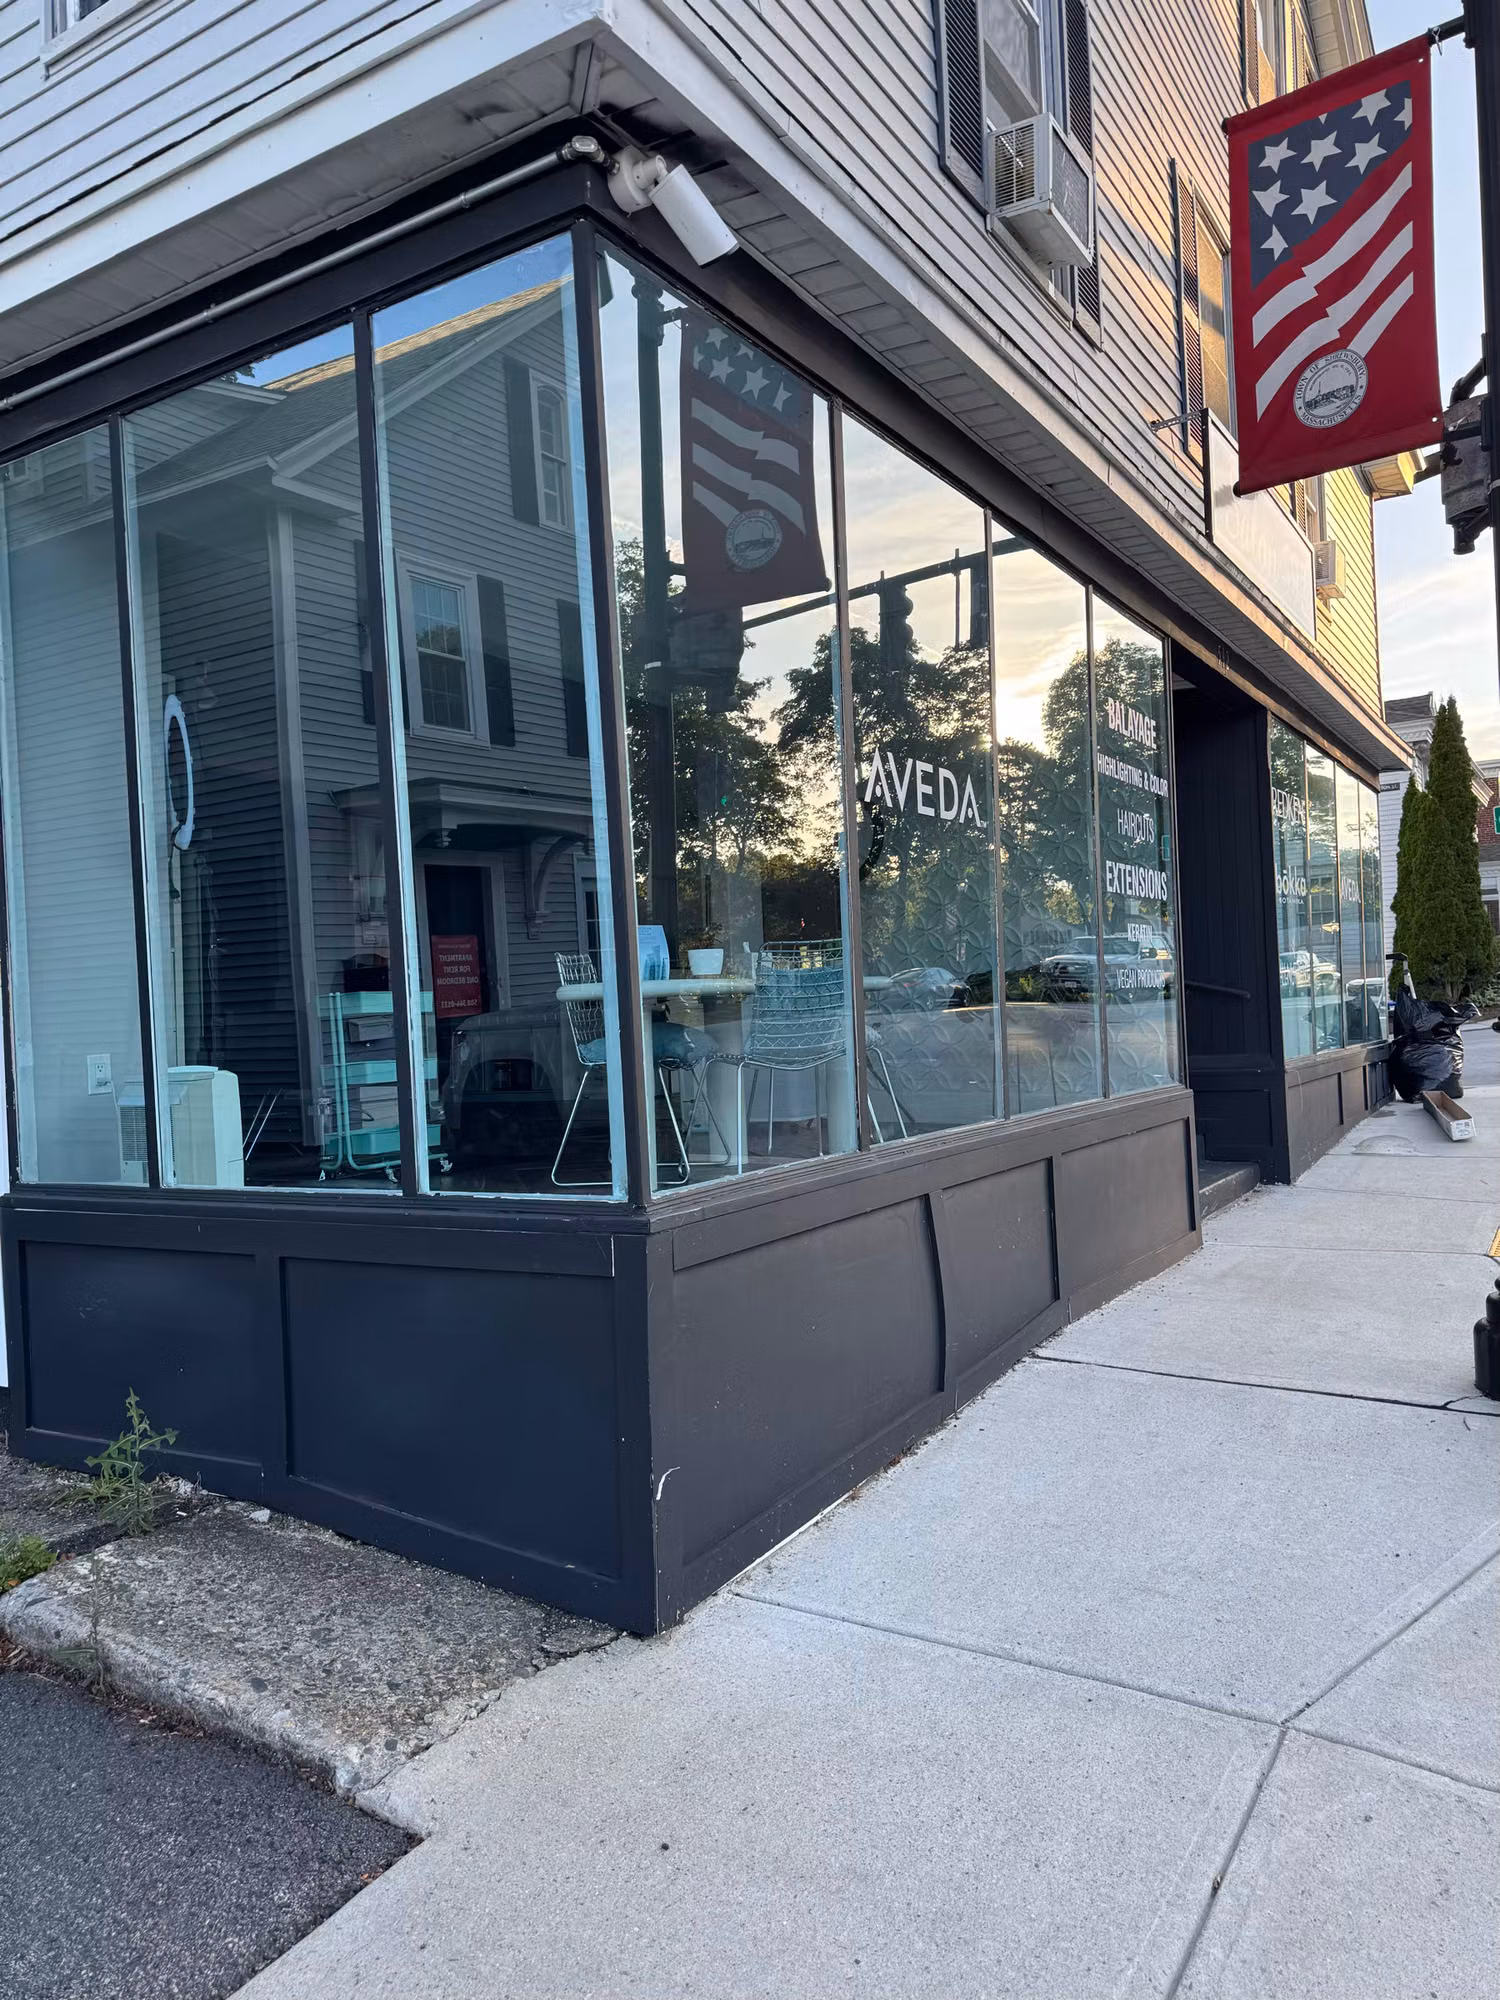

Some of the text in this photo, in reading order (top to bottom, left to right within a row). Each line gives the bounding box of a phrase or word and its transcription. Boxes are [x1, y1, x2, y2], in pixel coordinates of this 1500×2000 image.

[1296, 375, 1308, 400] TOWN
[1309, 363, 1320, 374] OF
[1107, 696, 1157, 750] BALAYAGE
[864, 746, 982, 828] AVEDA
[1097, 752, 1143, 788] HIGHLIGHTING
[1149, 774, 1169, 797] COLOR
[1117, 808, 1155, 844] HAIRCUTS
[1105, 860, 1168, 900] EXTENSIONS
[1127, 923, 1152, 943] KERATIN
[1116, 968, 1166, 988] VEGAN PRODUCTS
